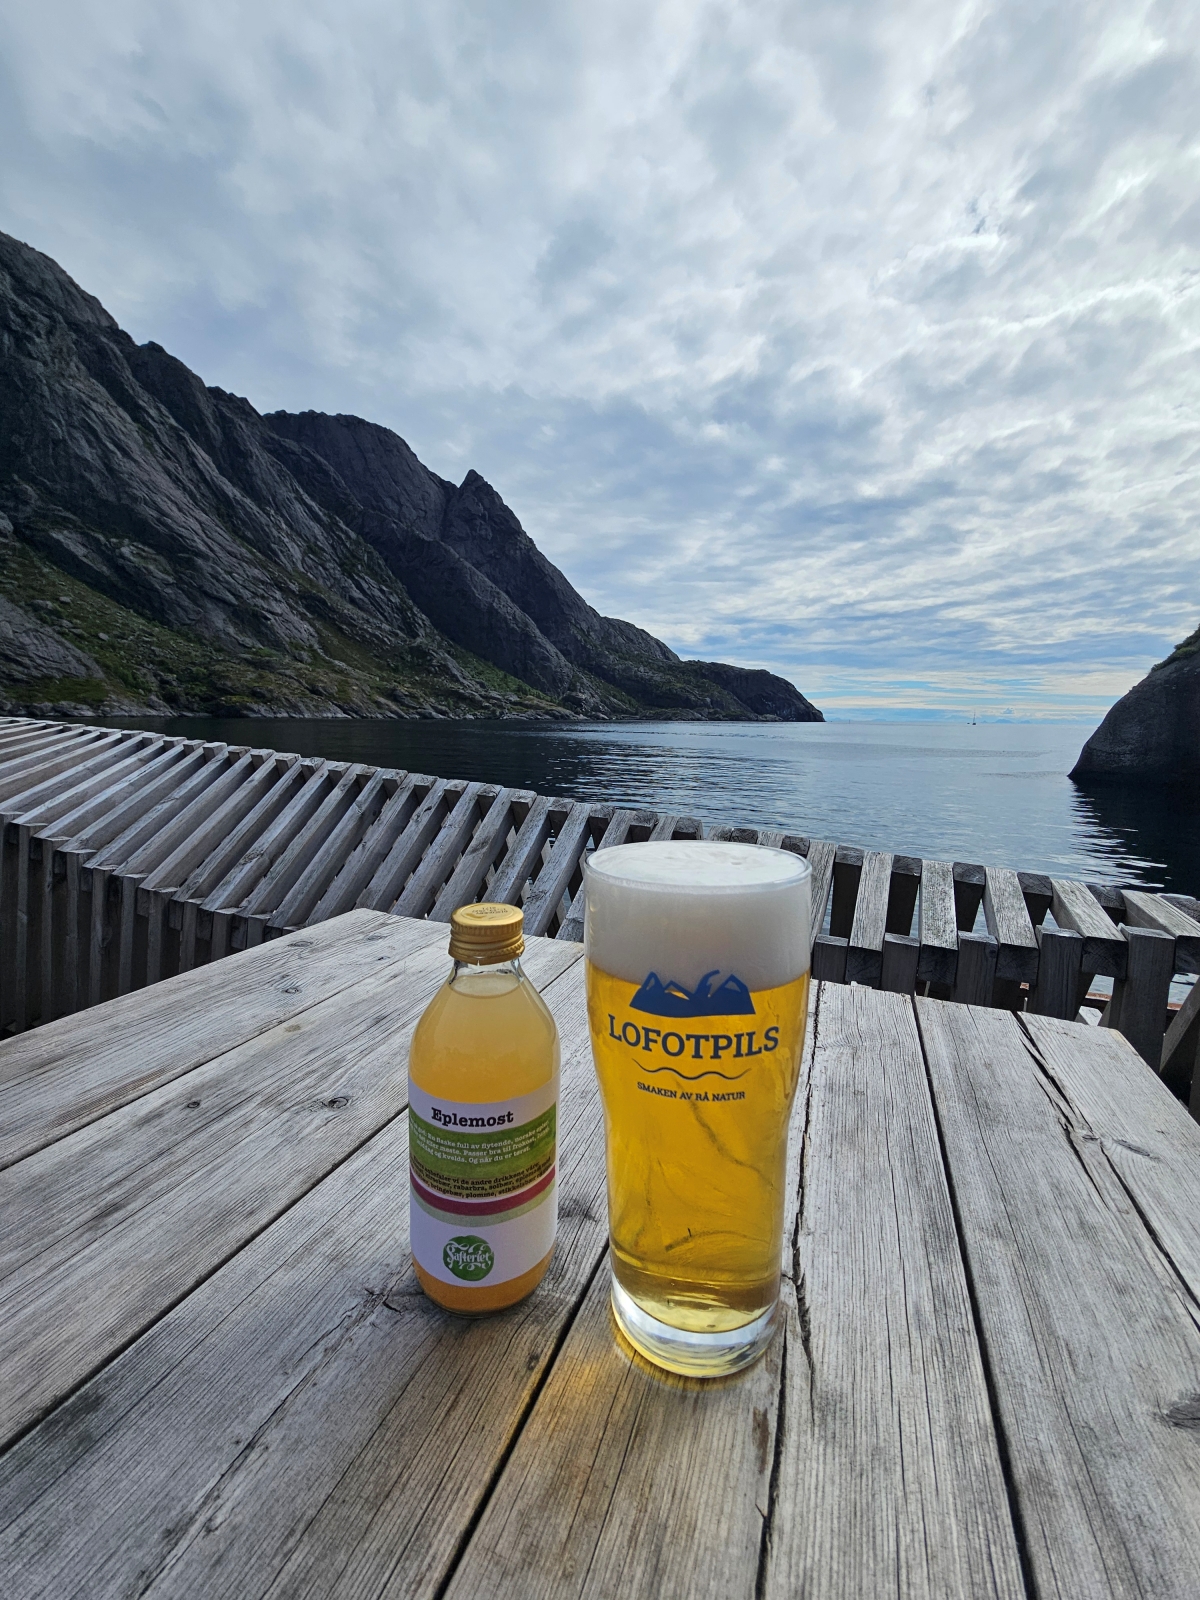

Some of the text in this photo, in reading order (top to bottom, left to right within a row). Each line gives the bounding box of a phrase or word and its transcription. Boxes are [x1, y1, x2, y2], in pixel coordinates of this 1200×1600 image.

[608, 1014, 780, 1059] LOFOTPILS
[637, 1081, 745, 1102] SMAKEN AV RÅ NATUR
[431, 1107, 514, 1127] Eplemost
[437, 1138, 455, 1146] flaske
[482, 1140, 513, 1149] flytende,
[443, 1153, 467, 1162] kvelds.
[494, 1171, 524, 1183] drikkene
[454, 1183, 487, 1191] rabarbra,
